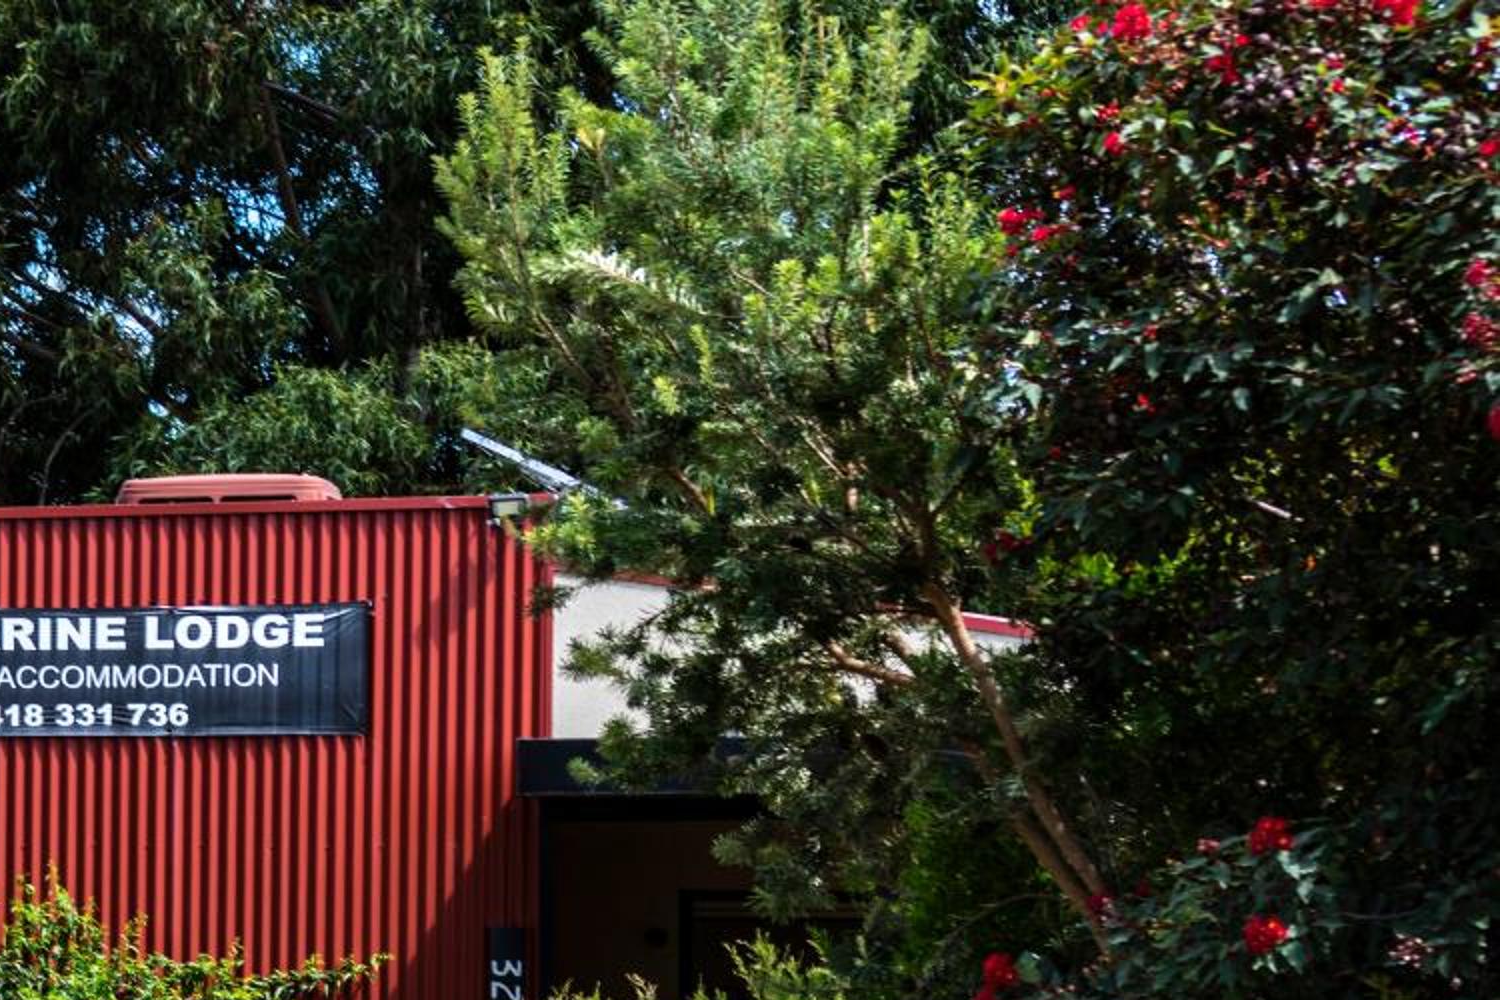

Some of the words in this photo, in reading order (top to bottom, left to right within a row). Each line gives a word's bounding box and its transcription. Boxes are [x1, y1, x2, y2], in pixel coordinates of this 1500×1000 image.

[145, 613, 325, 650] LODGE
[55, 703, 113, 727] 331
[127, 702, 189, 727] 736
